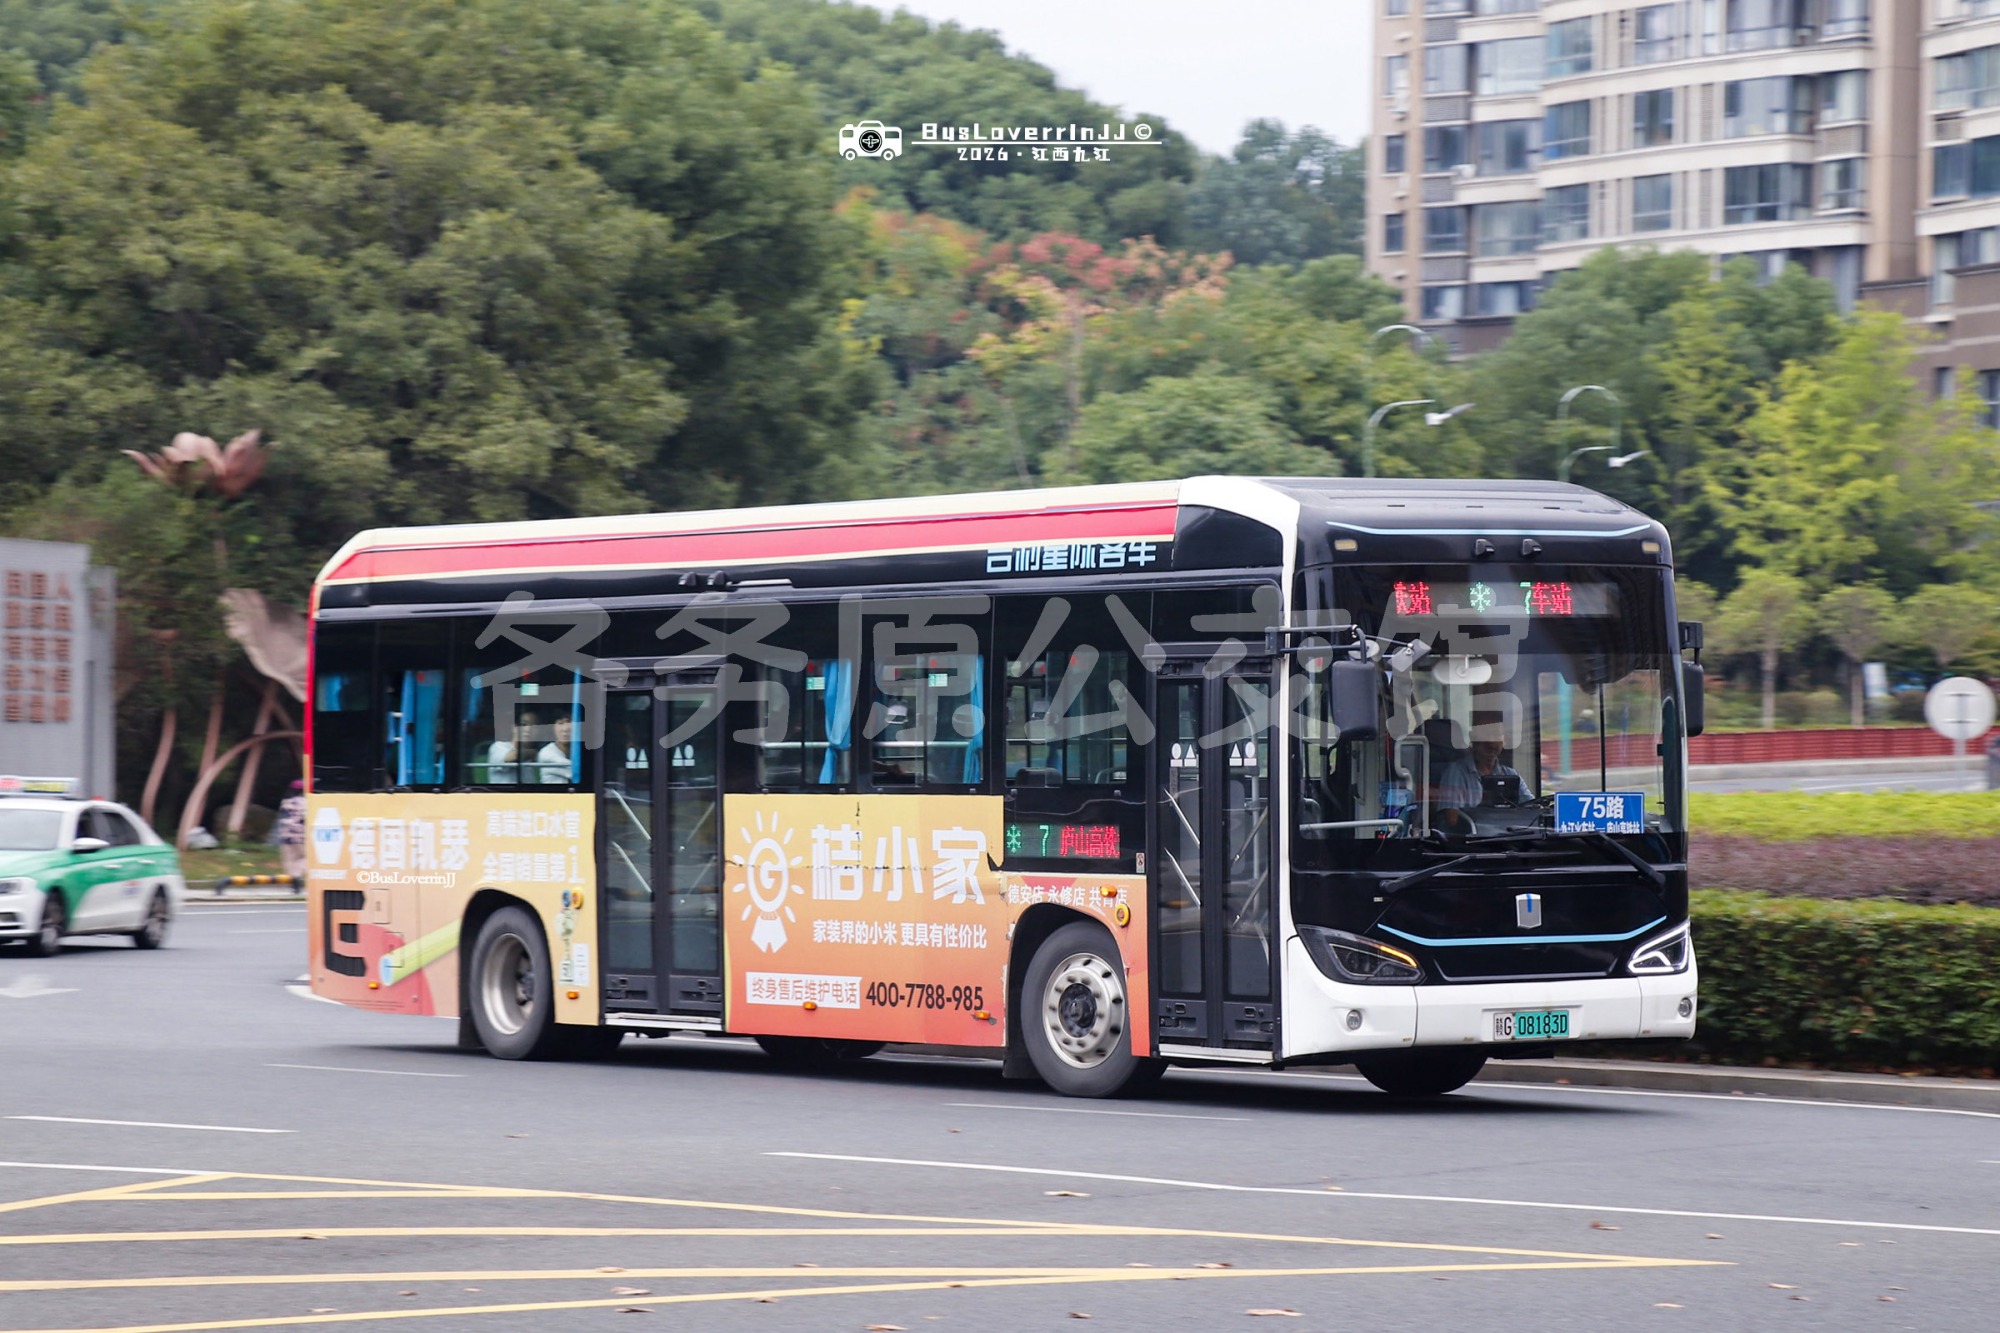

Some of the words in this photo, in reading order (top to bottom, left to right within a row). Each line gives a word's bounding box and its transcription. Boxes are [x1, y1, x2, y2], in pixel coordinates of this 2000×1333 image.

[1578, 796, 1624, 819] 75路
[1039, 824, 1049, 857] 7
[810, 823, 987, 905] 桔小家
[1007, 884, 1044, 904] 德安店
[1047, 885, 1085, 906] 永修店
[812, 919, 898, 946] 家装界的小米
[900, 922, 988, 949] 更具有性价比
[752, 977, 858, 1004] 终身售后维护电话
[866, 981, 983, 1011] 400-7788-985
